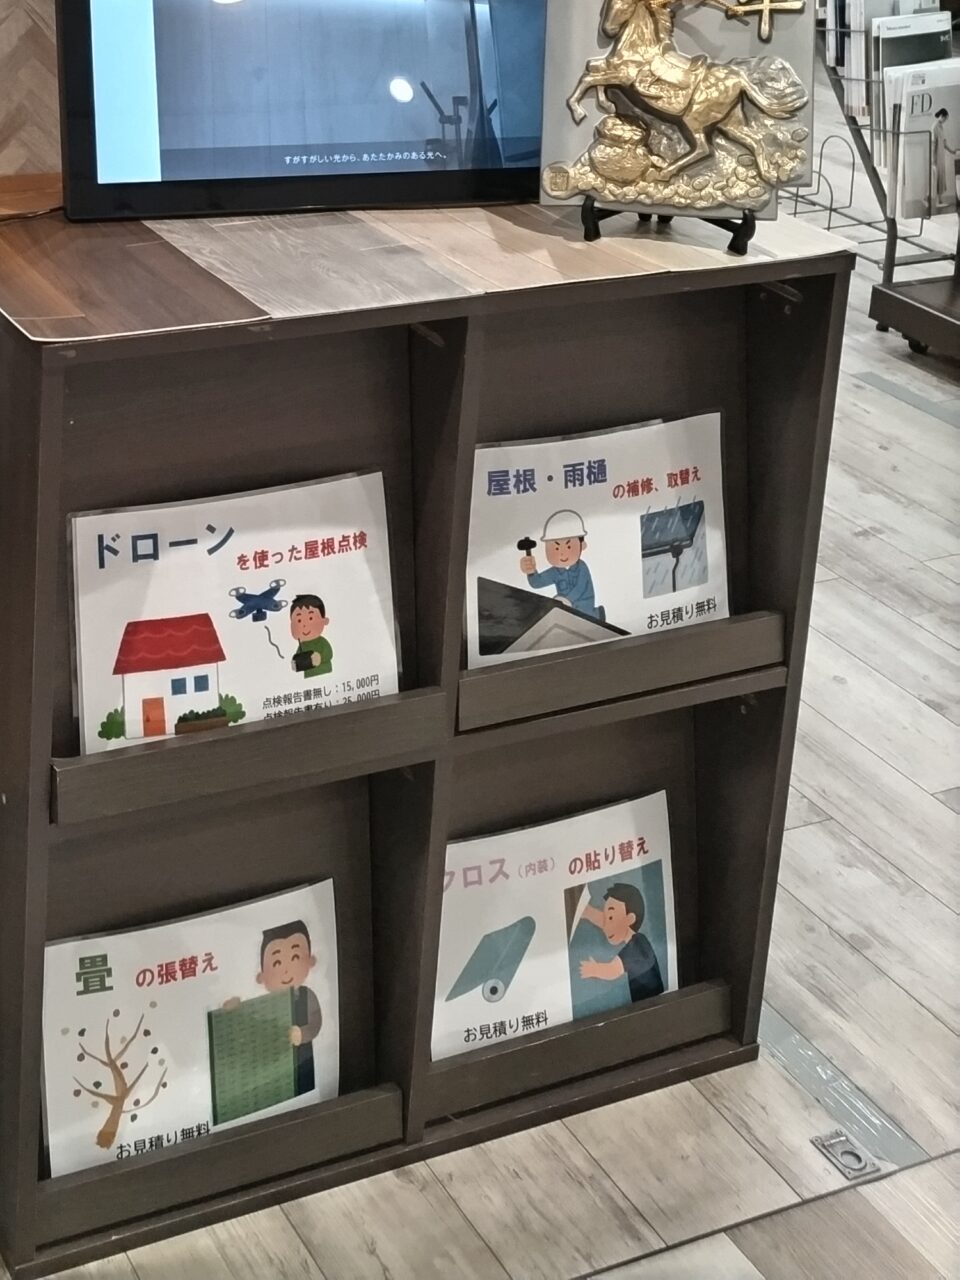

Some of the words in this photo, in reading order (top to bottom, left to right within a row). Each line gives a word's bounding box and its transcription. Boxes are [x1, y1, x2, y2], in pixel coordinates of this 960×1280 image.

[486, 458, 608, 497] 屋根・雨樋
[612, 466, 702, 500] の補修、取替え
[97, 523, 235, 569] ドローン
[235, 530, 368, 571] を使った屋根点検
[646, 596, 718, 630] お見積り無料
[568, 836, 650, 876] の貼り替え
[74, 952, 114, 997] 畳
[135, 951, 219, 989] の張替え
[463, 1010, 548, 1043] お見積り無料
[115, 1120, 212, 1161] お見積り無料
